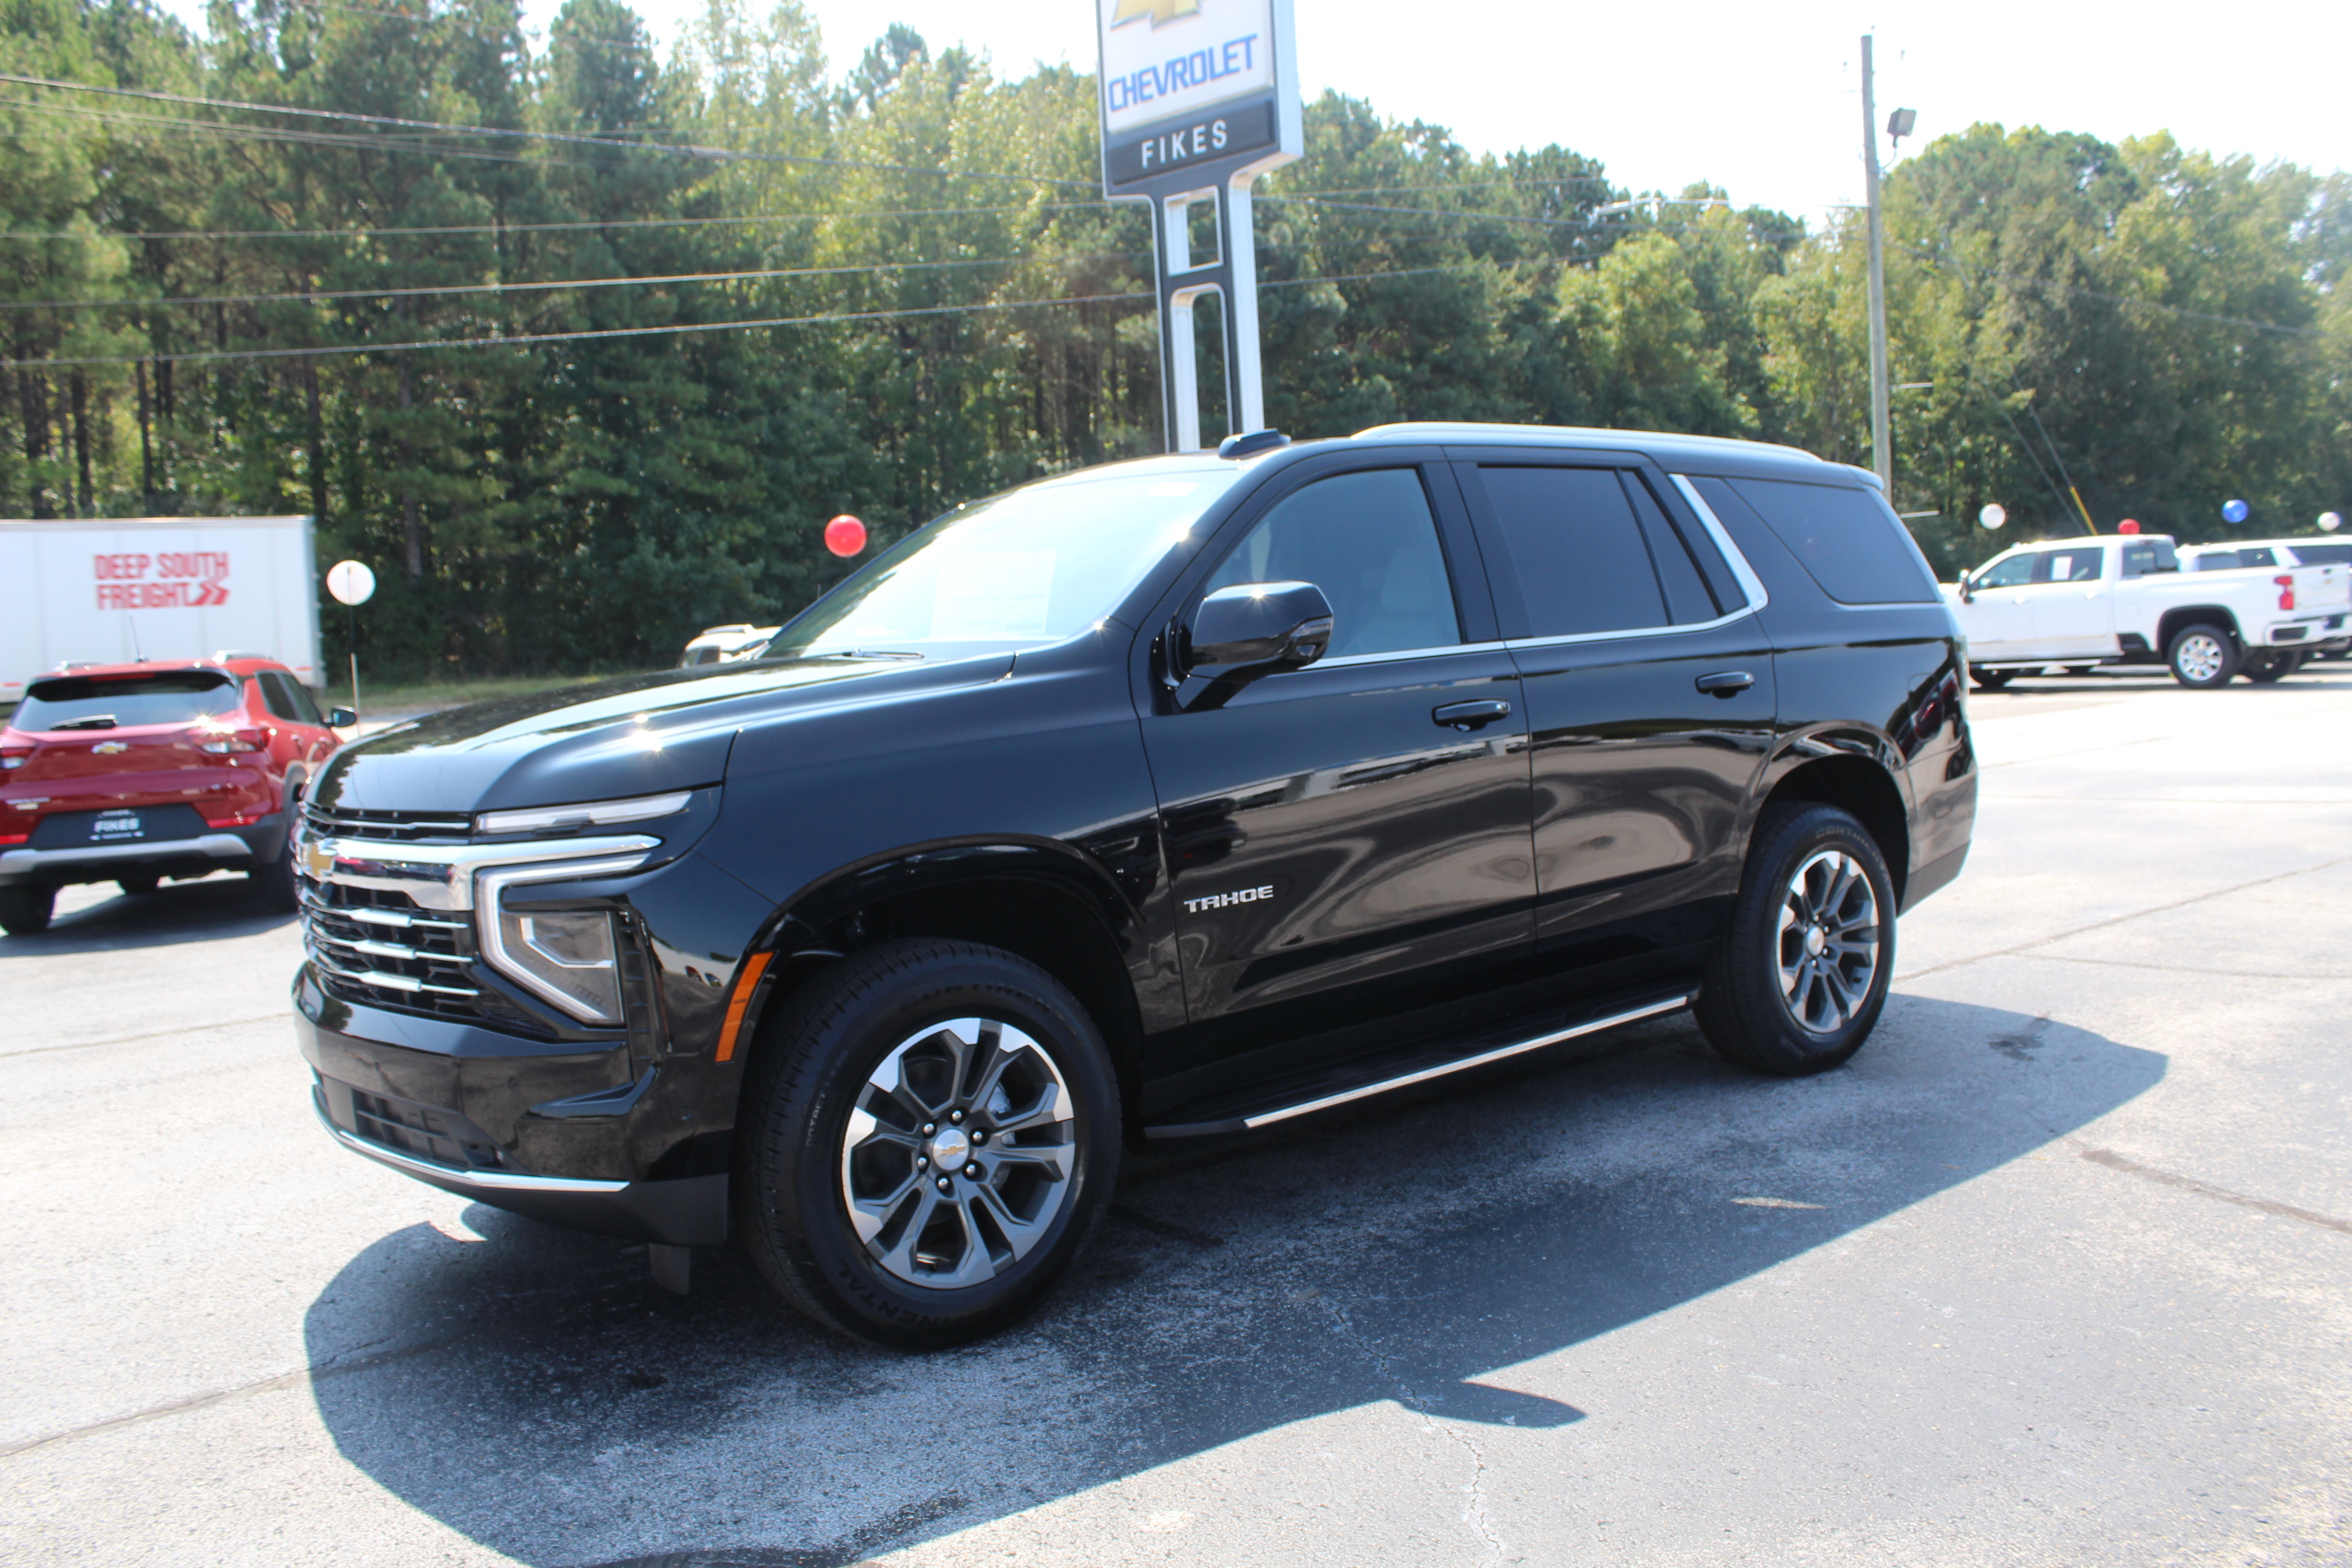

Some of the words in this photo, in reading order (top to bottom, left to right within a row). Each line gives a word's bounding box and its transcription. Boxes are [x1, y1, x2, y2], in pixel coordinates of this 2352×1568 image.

[1108, 33, 1258, 113] CHEVROLET
[1141, 119, 1228, 169] FIKES
[94, 554, 152, 580] DEEP
[157, 552, 229, 578] SOUTH
[96, 582, 191, 610] FREIGHT
[1183, 885, 1274, 914] TAHOE
